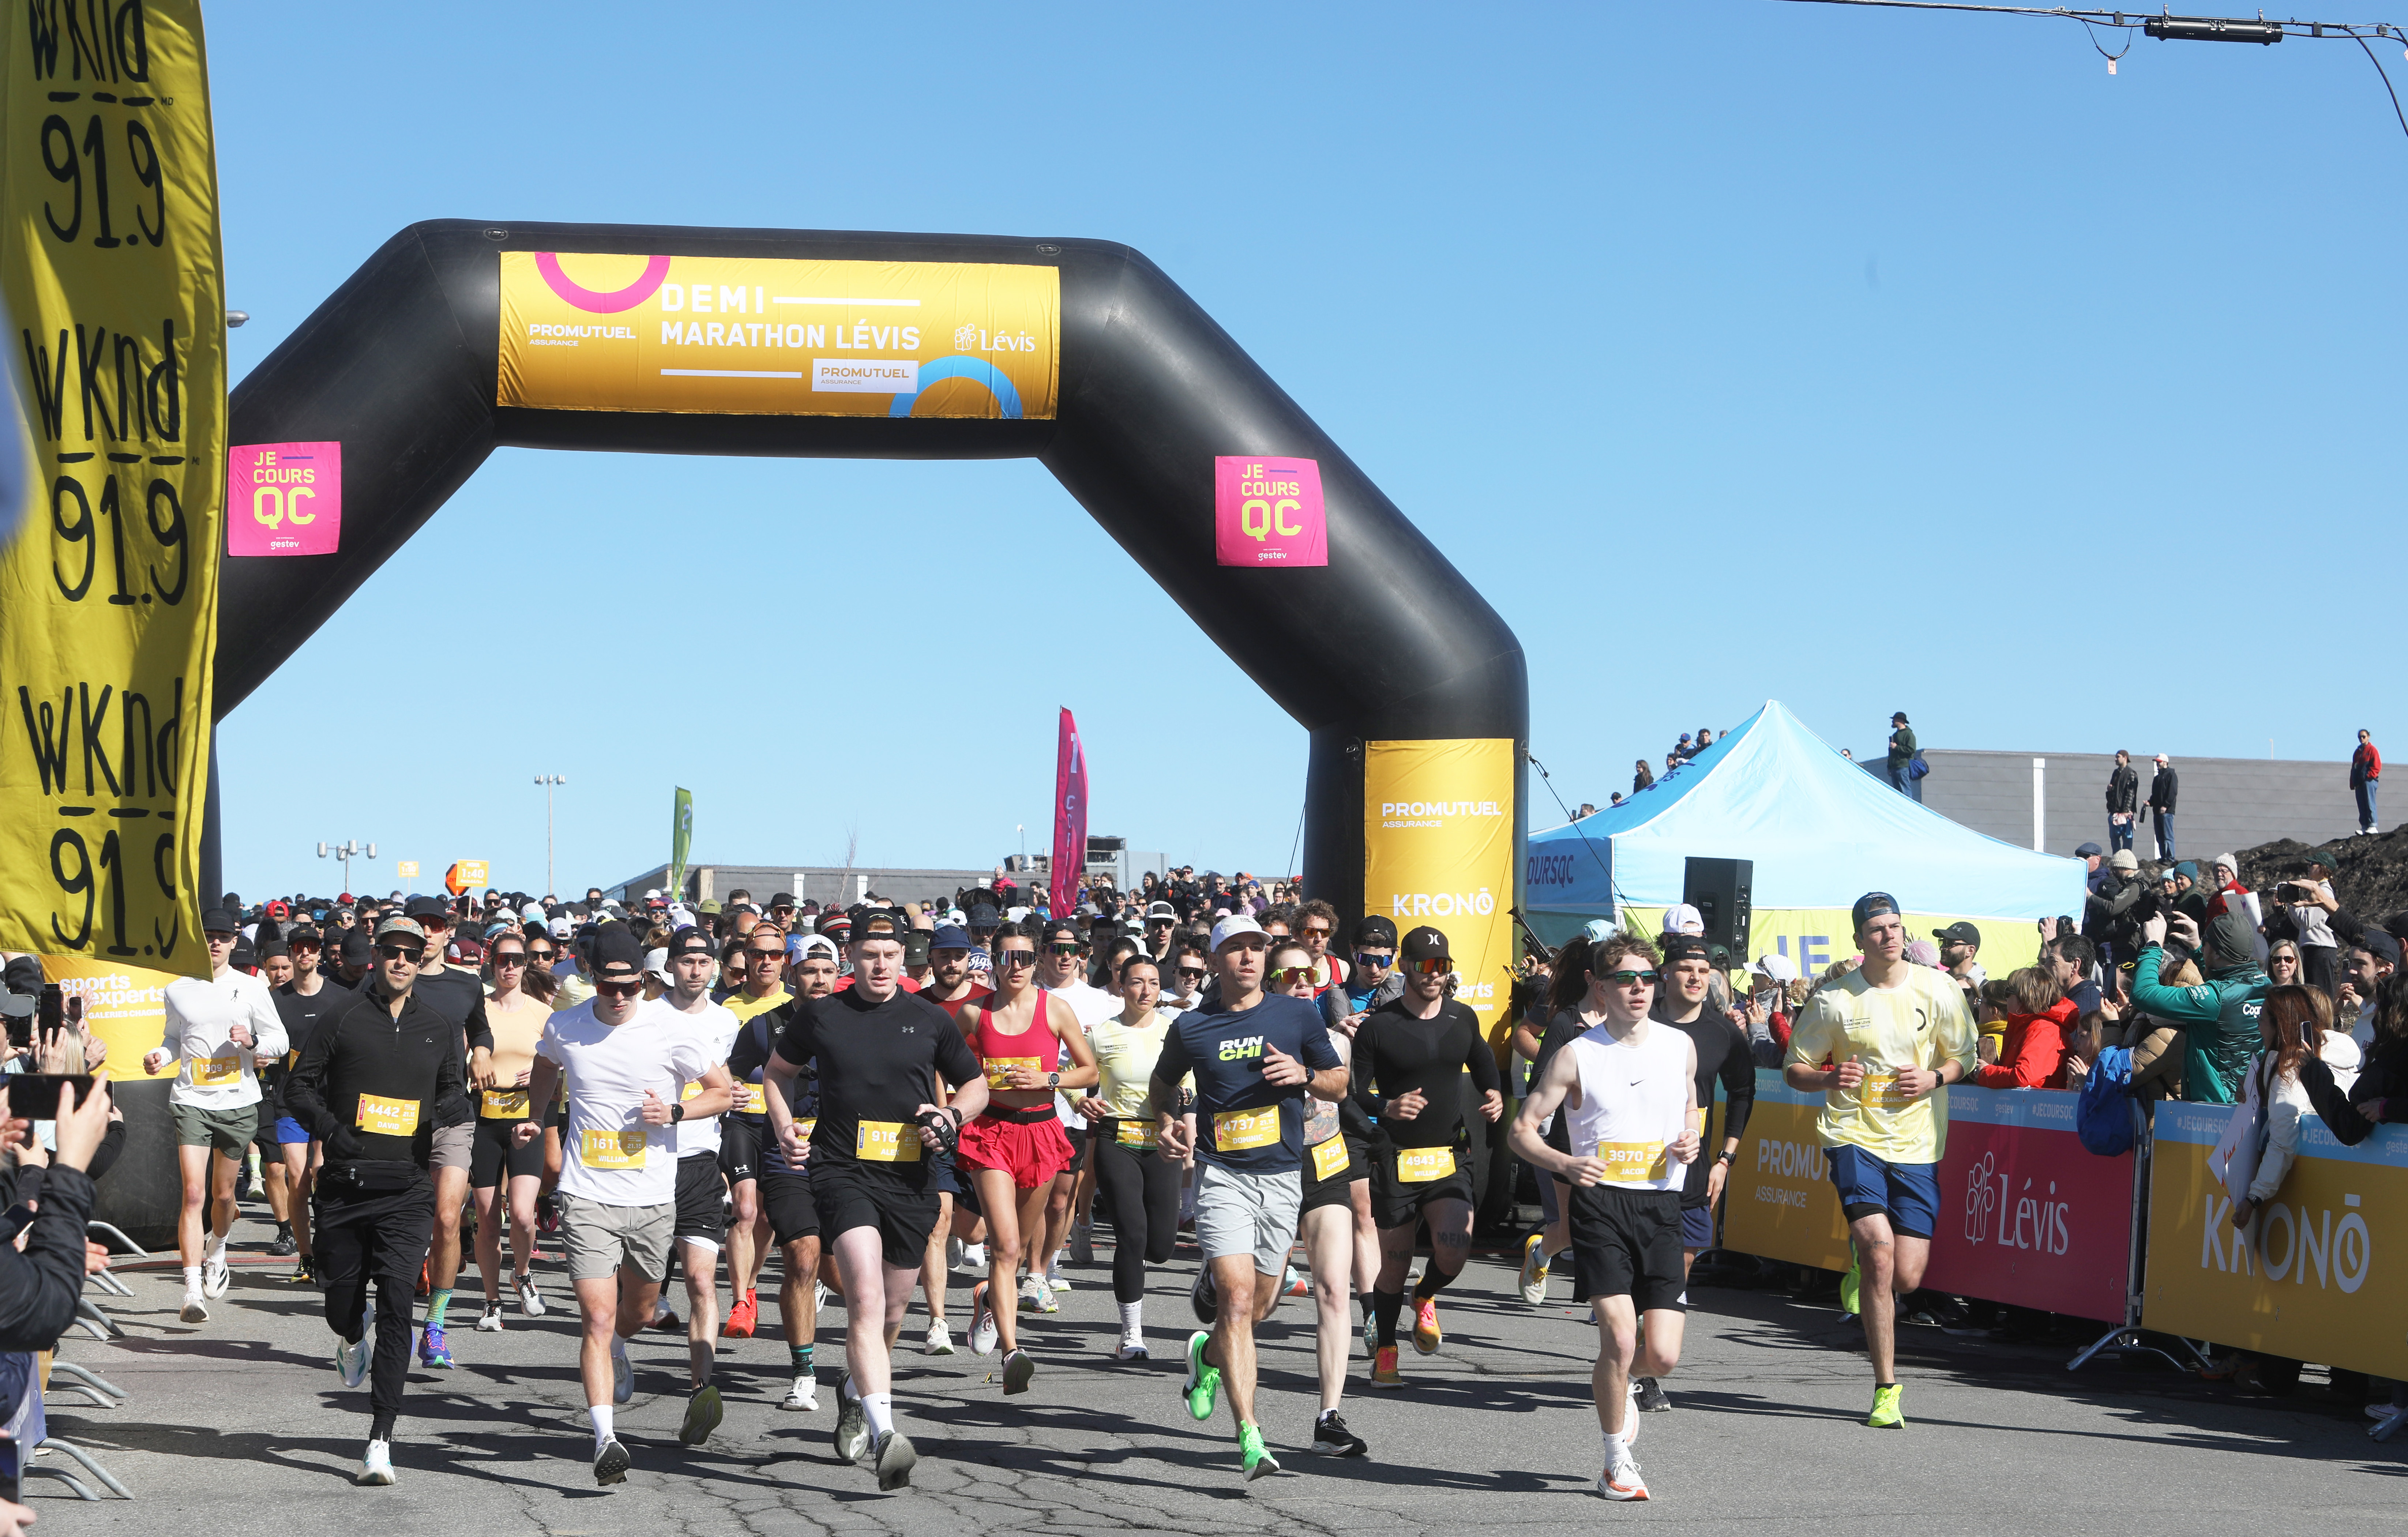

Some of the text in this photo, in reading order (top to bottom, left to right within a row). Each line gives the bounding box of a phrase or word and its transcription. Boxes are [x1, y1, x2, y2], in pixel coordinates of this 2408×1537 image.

[161, 97, 174, 106] MD
[41, 114, 166, 248] 91.9
[661, 283, 763, 313] DEMI
[529, 324, 636, 339] PROMUTUEL
[661, 319, 920, 350] MARATHON LÉVIS
[978, 330, 1035, 352] Lévis
[820, 367, 909, 378] PROMUTUEL
[254, 451, 276, 466] JE
[253, 469, 315, 483] COURS
[1241, 464, 1263, 478] JE
[1241, 481, 1300, 496] COURS
[253, 486, 316, 529] QC
[1241, 499, 1302, 541] QC
[53, 475, 188, 606] 91.9
[271, 540, 299, 550] gestev
[1258, 551, 1287, 561] gestev
[1382, 801, 1502, 817] PROMUTUEL
[462, 868, 484, 878] 1:40
[50, 828, 177, 960] 91.9
[60, 973, 131, 995] sports
[1458, 981, 1493, 998] erts
[91, 985, 165, 1008] experts
[88, 1010, 128, 1019] GALERIES
[1219, 1036, 1263, 1051] RUN
[1219, 1045, 1262, 1061] CHI
[200, 1064, 222, 1073] 1309
[367, 1104, 400, 1117] 4442
[1995, 1102, 2014, 1116] gestev
[2032, 1103, 2073, 1121] #JECOURSQC
[377, 1121, 399, 1130] DAVID
[1223, 1117, 1255, 1131] 4737
[592, 1138, 621, 1150] 1611
[871, 1130, 897, 1143] 916
[1233, 1134, 1264, 1144] DOMINIC
[1323, 1143, 1341, 1160] 758
[2386, 1140, 2408, 1156] geste
[1406, 1155, 1435, 1166] 4943
[1608, 1150, 1643, 1162] 3970
[1755, 1185, 1807, 1208] ASSURANCE
[1998, 1177, 2069, 1255] Lévis
